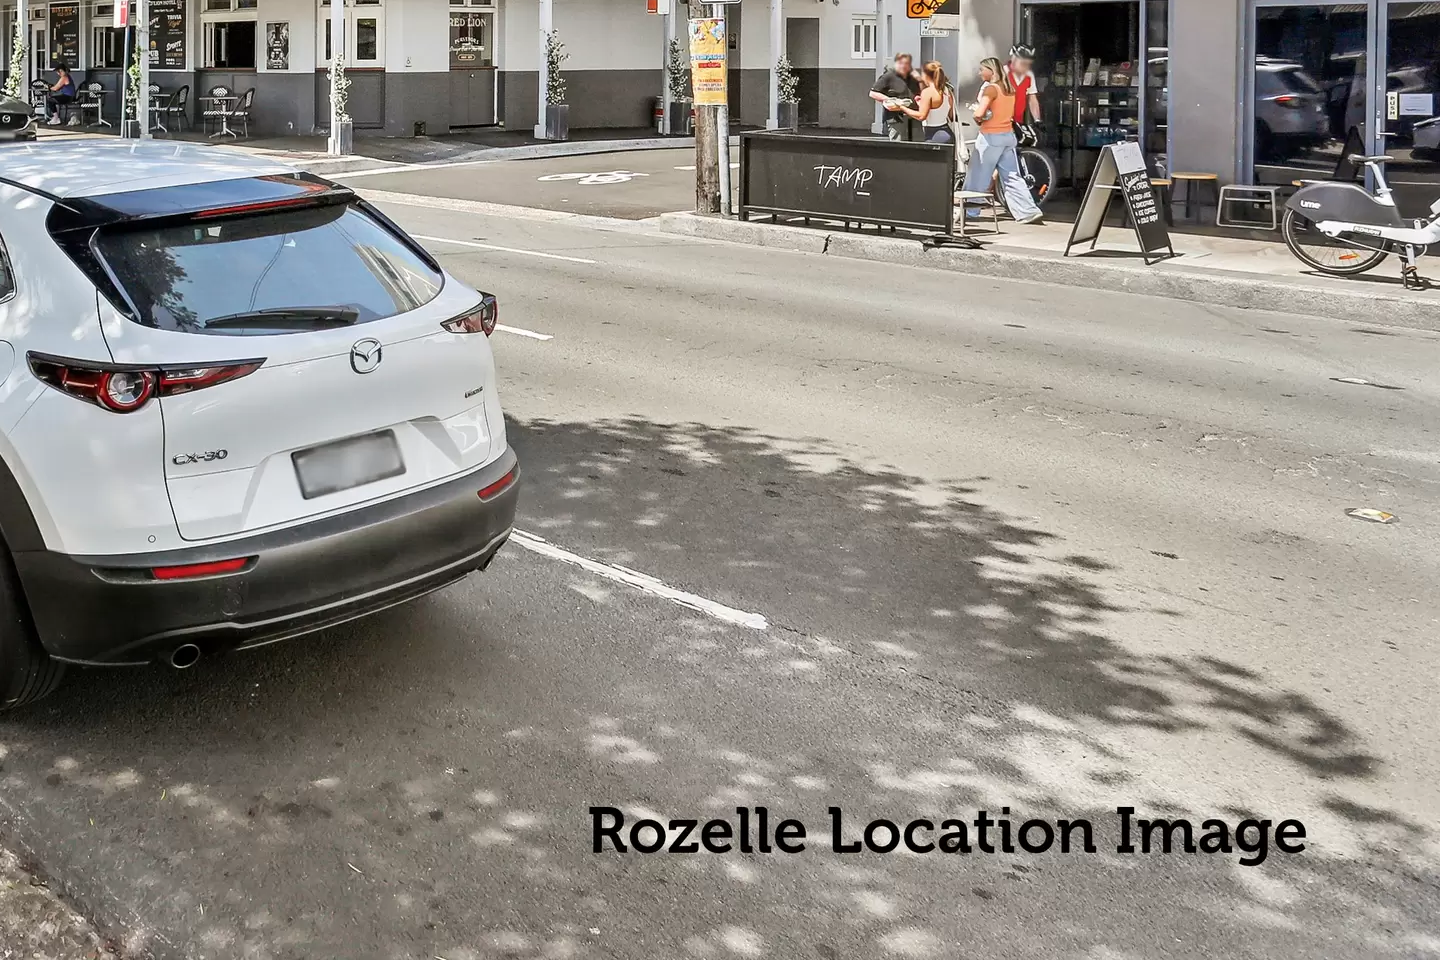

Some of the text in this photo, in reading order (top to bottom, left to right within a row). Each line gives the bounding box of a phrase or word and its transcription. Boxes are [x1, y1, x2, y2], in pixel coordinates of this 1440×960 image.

[449, 17, 487, 27] RED LION
[813, 164, 873, 189] TAMP
[172, 449, 228, 465] CX-30
